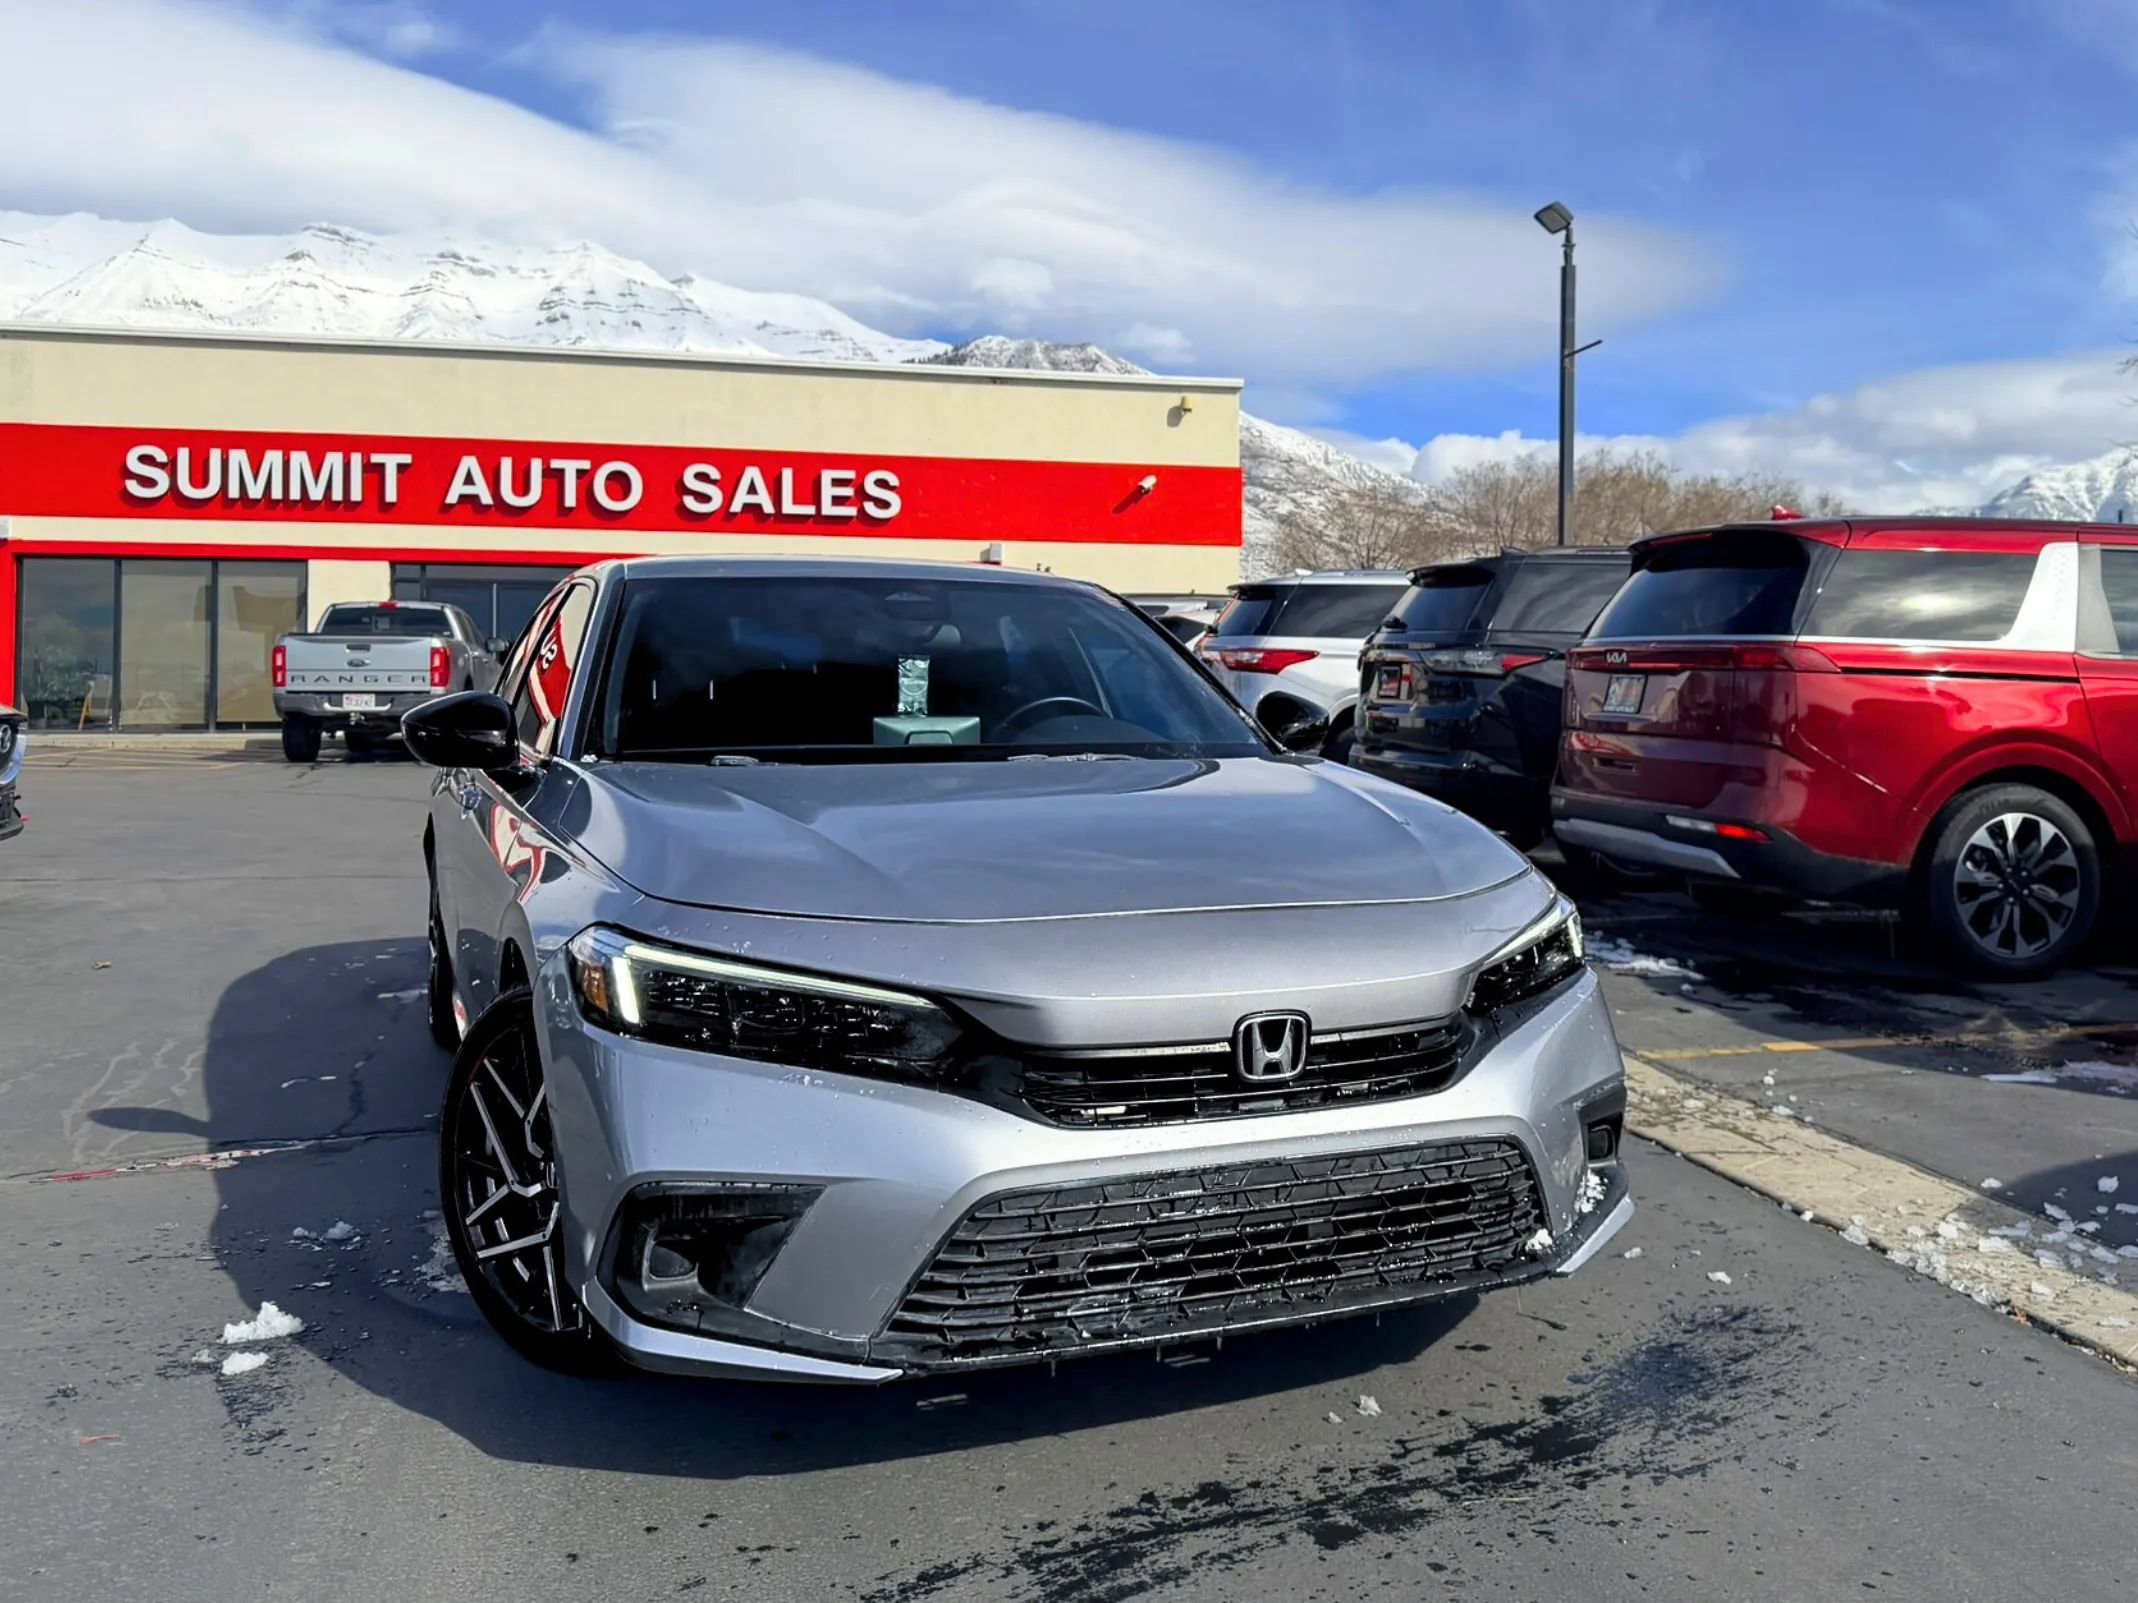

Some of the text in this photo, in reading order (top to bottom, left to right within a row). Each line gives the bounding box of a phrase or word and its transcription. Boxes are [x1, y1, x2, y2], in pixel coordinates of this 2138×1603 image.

[123, 444, 902, 519] SUMMIT AUTO SALES
[290, 674, 426, 684] RANGER
